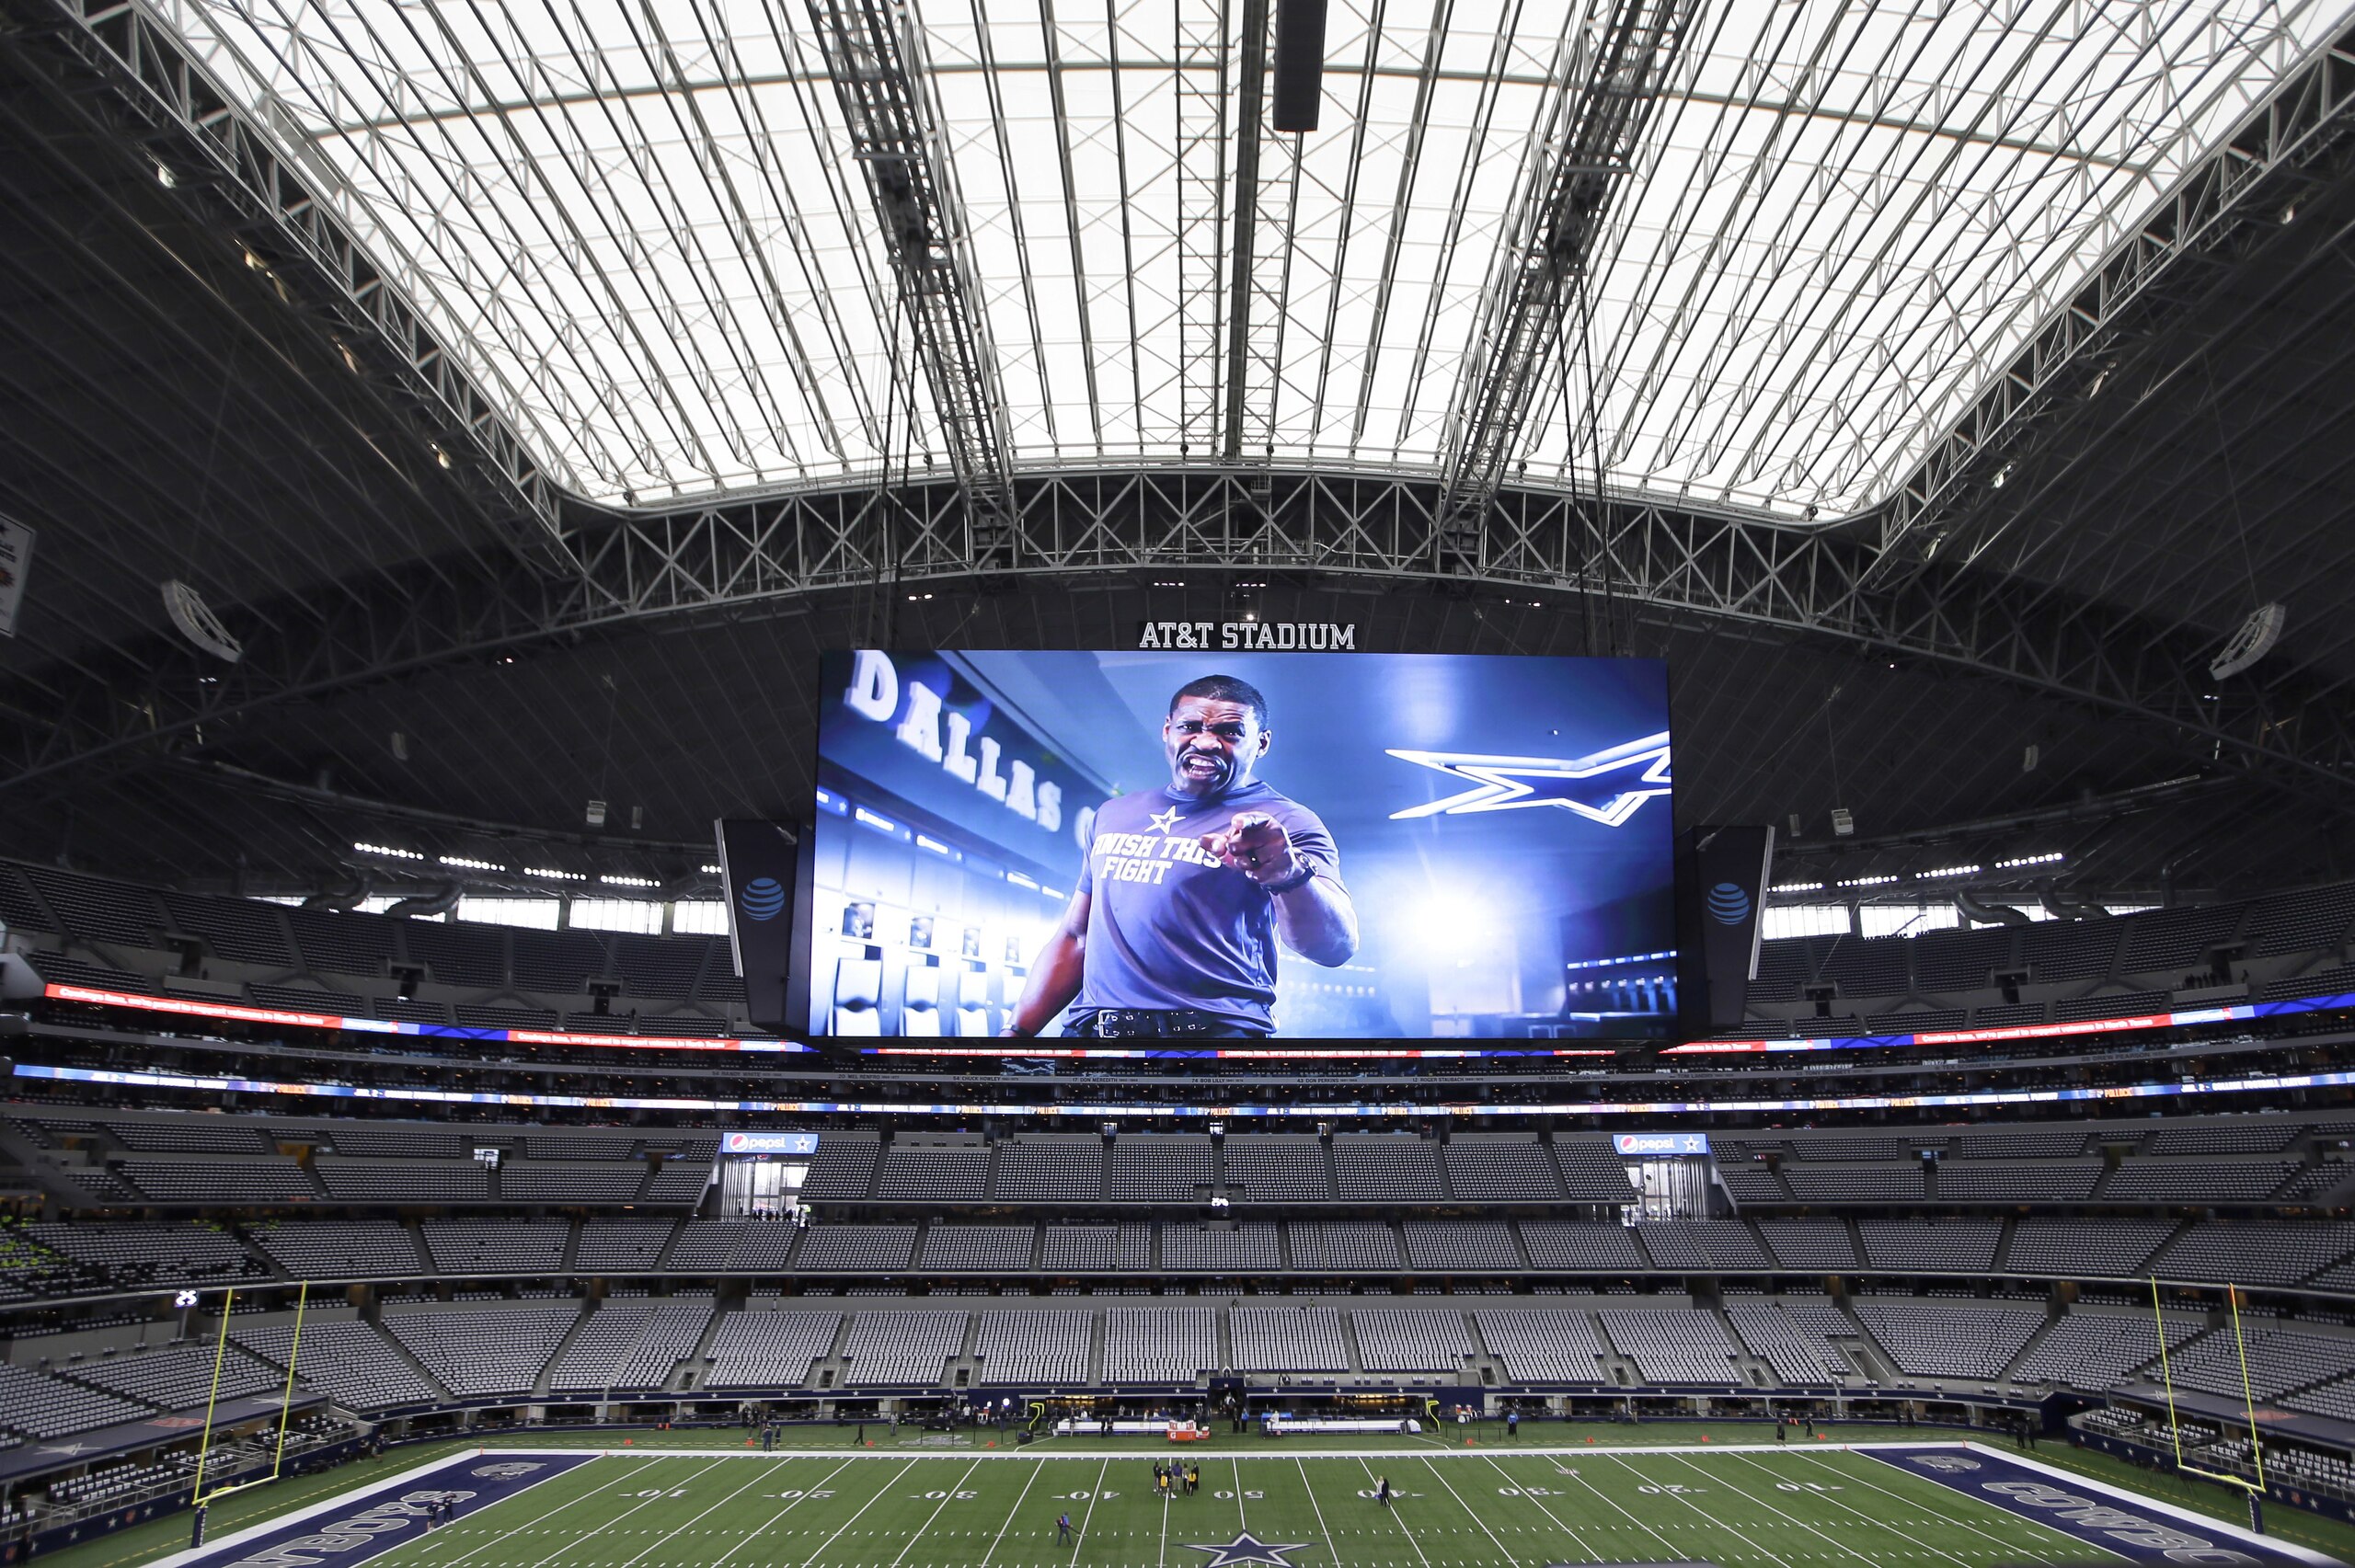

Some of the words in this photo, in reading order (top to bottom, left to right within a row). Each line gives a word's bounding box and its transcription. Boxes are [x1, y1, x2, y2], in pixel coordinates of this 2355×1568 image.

[1139, 623, 1213, 647] AT&T
[1223, 624, 1355, 649] STADIUM
[844, 649, 1062, 832] DALLAS
[1100, 855, 1174, 885] FIGHT
[2105, 1021, 2127, 1029] North
[2105, 1087, 2131, 1098] POLLOCK
[776, 1103, 799, 1111] POLLOCK
[1037, 1106, 1058, 1115] POLLOCK
[1210, 1107, 1230, 1116] POLLOCK
[749, 1138, 786, 1150] pepsi
[1639, 1138, 1674, 1150] pepsi
[925, 1491, 978, 1500] 30
[1069, 1491, 1120, 1500] 40
[1213, 1490, 1265, 1499] 50
